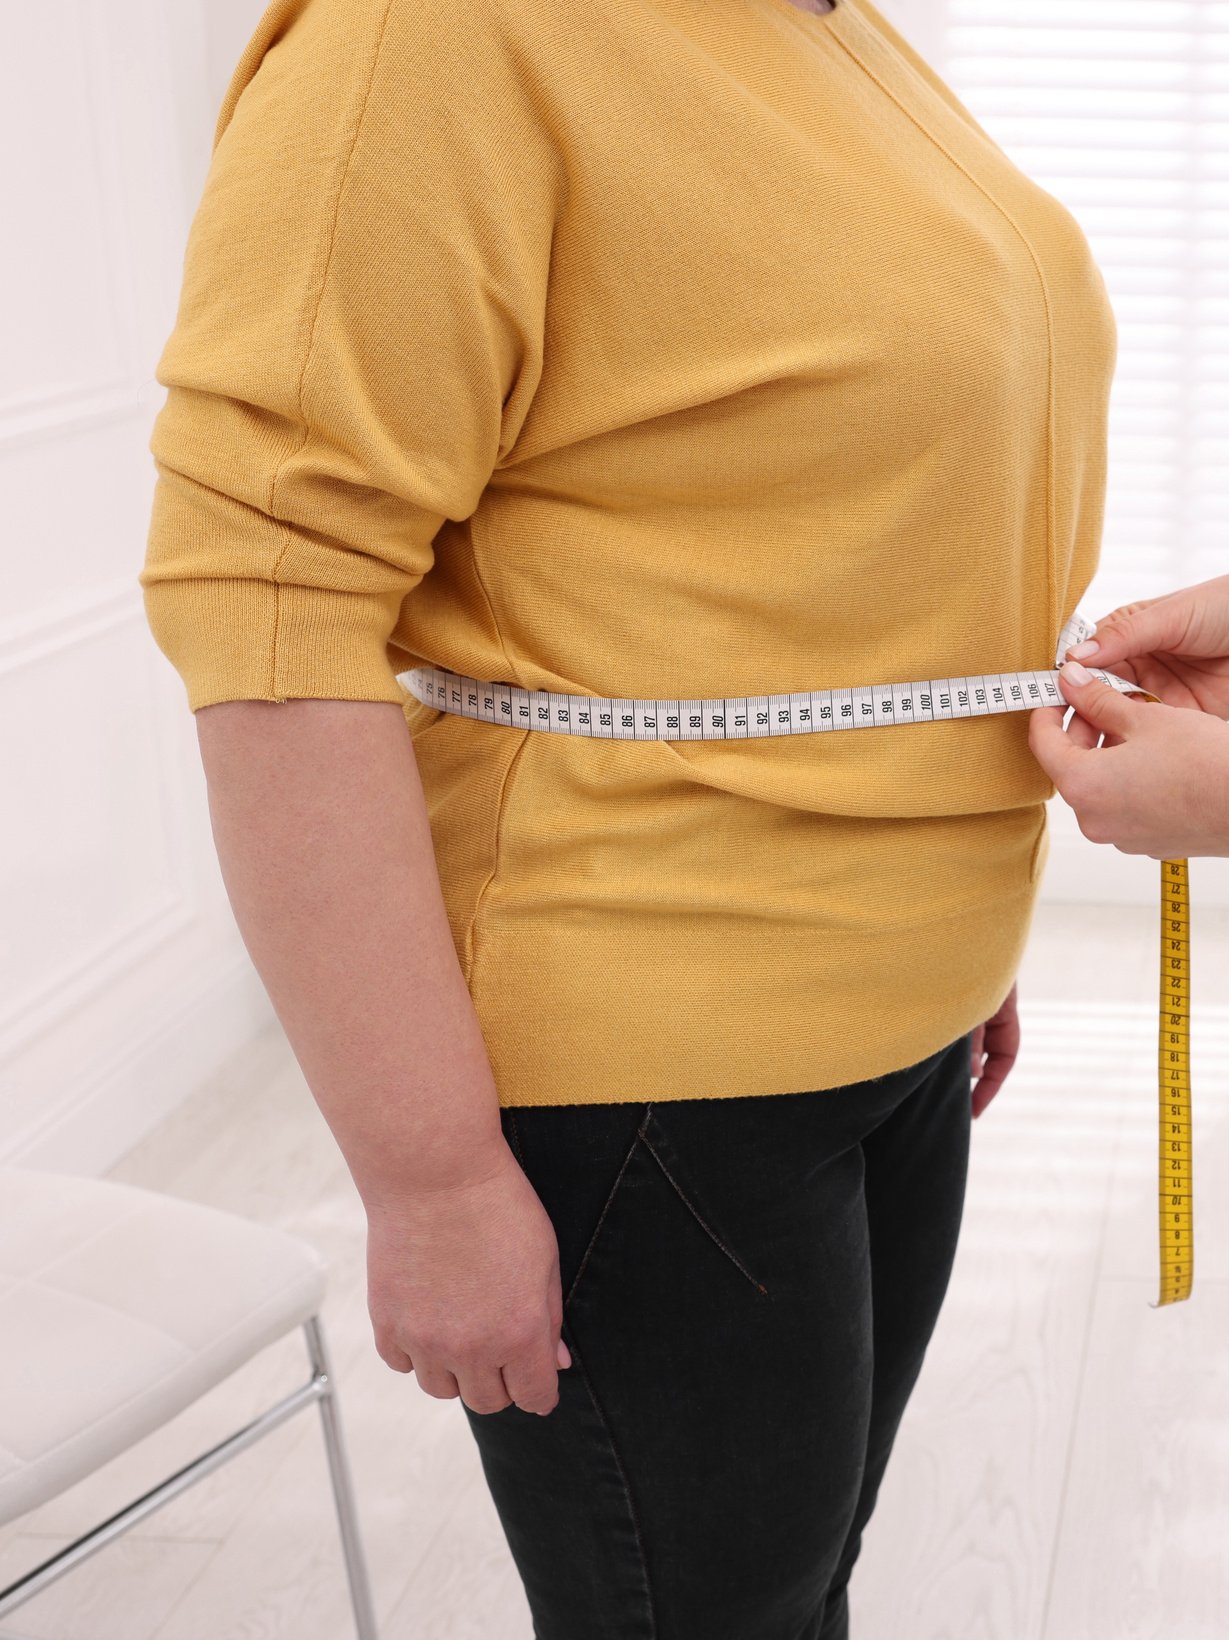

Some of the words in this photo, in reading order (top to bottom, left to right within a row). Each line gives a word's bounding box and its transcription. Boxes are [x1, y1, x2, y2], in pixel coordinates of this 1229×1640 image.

[438, 687, 445, 699] 76
[993, 687, 1003, 703] 104
[1011, 685, 1021, 701] 105
[1028, 684, 1039, 699] 106
[1045, 683, 1056, 697] 107
[452, 691, 460, 703] 77
[468, 694, 477, 706] 78
[920, 694, 931, 710] 100
[940, 694, 950, 709] 101
[958, 691, 968, 707] 102
[975, 689, 986, 705] 103
[485, 698, 493, 709] 79
[501, 701, 511, 714] 80
[862, 703, 872, 715] 97
[882, 700, 892, 713] 98
[902, 698, 912, 711] 99
[519, 705, 529, 717] 81
[538, 707, 548, 719] 82
[558, 710, 568, 722] 83
[778, 710, 789, 722] 93
[800, 709, 810, 721] 94
[821, 706, 831, 718] 95
[841, 704, 851, 716] 96
[579, 712, 589, 724] 84
[600, 713, 611, 726] 85
[622, 715, 633, 727] 86
[644, 716, 655, 728] 87
[667, 716, 678, 728] 88
[690, 716, 701, 727] 89
[712, 715, 723, 727] 90
[735, 715, 746, 726] 91
[757, 712, 768, 724] 92
[1171, 865, 1180, 875] 28
[1171, 885, 1180, 894] 27
[1171, 903, 1181, 913] 26
[1171, 922, 1181, 932] 25
[1172, 941, 1180, 951] 24
[1171, 960, 1181, 969] 23
[1171, 978, 1181, 988] 22
[1172, 997, 1181, 1006] 21
[1170, 1016, 1181, 1025] 20
[1171, 1034, 1179, 1043] 19
[1170, 1053, 1179, 1062] 18
[1171, 1071, 1180, 1080] 17
[1171, 1089, 1180, 1098] 16
[1171, 1106, 1181, 1115] 15
[1172, 1125, 1181, 1134] 14
[1172, 1142, 1181, 1151] 13
[1172, 1161, 1181, 1170] 12
[1173, 1179, 1181, 1188] 11
[1172, 1196, 1181, 1205] 10
